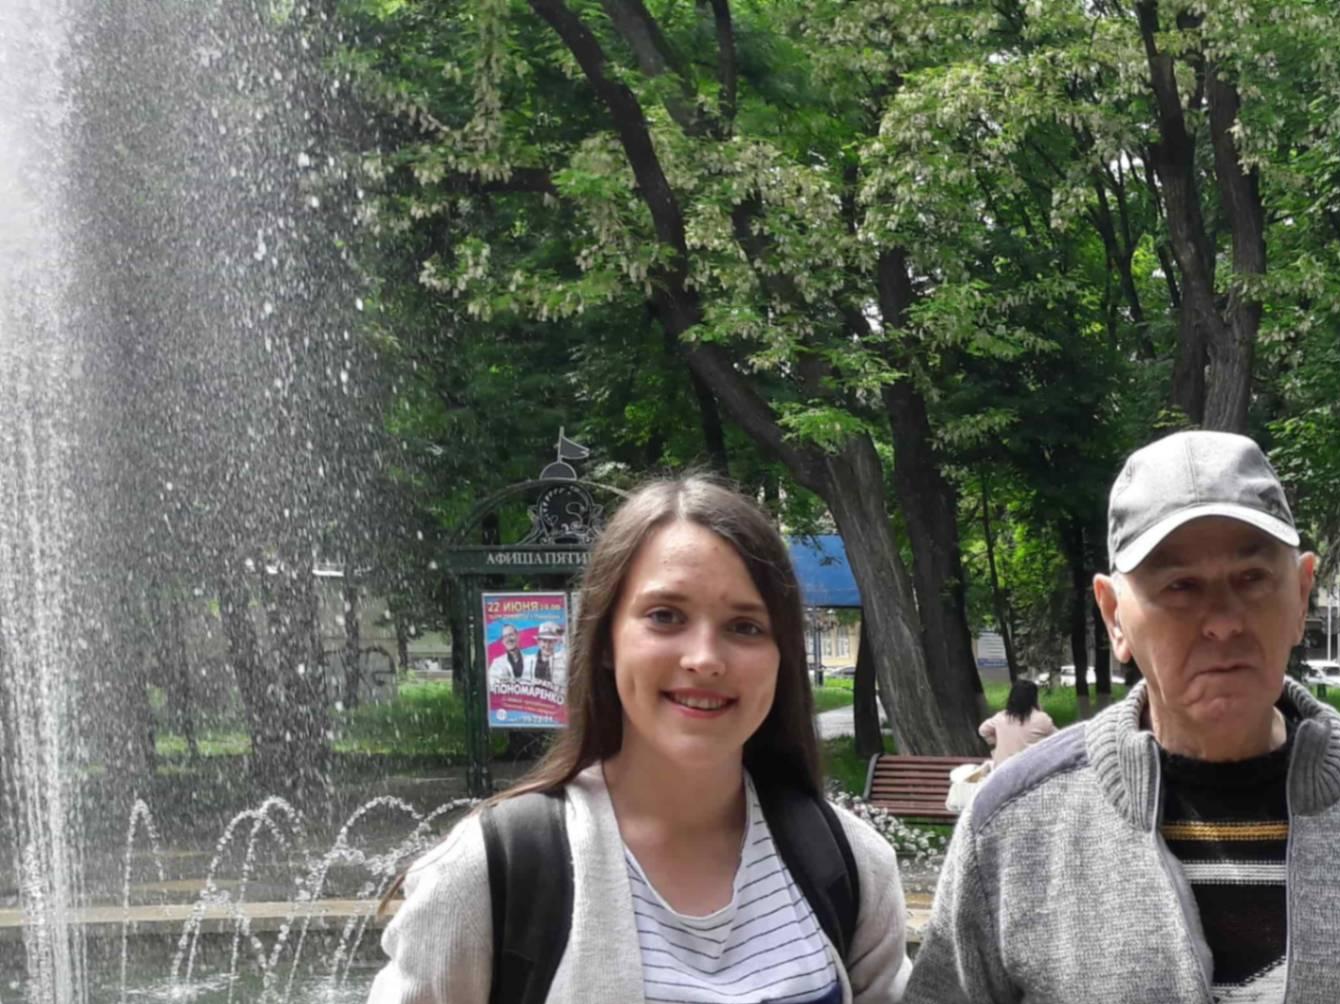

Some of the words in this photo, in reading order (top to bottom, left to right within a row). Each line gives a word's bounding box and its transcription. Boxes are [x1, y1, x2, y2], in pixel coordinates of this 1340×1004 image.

[486, 551, 543, 565] АФИША
[487, 602, 500, 612] 22
[503, 601, 538, 613] ИЮНЯ
